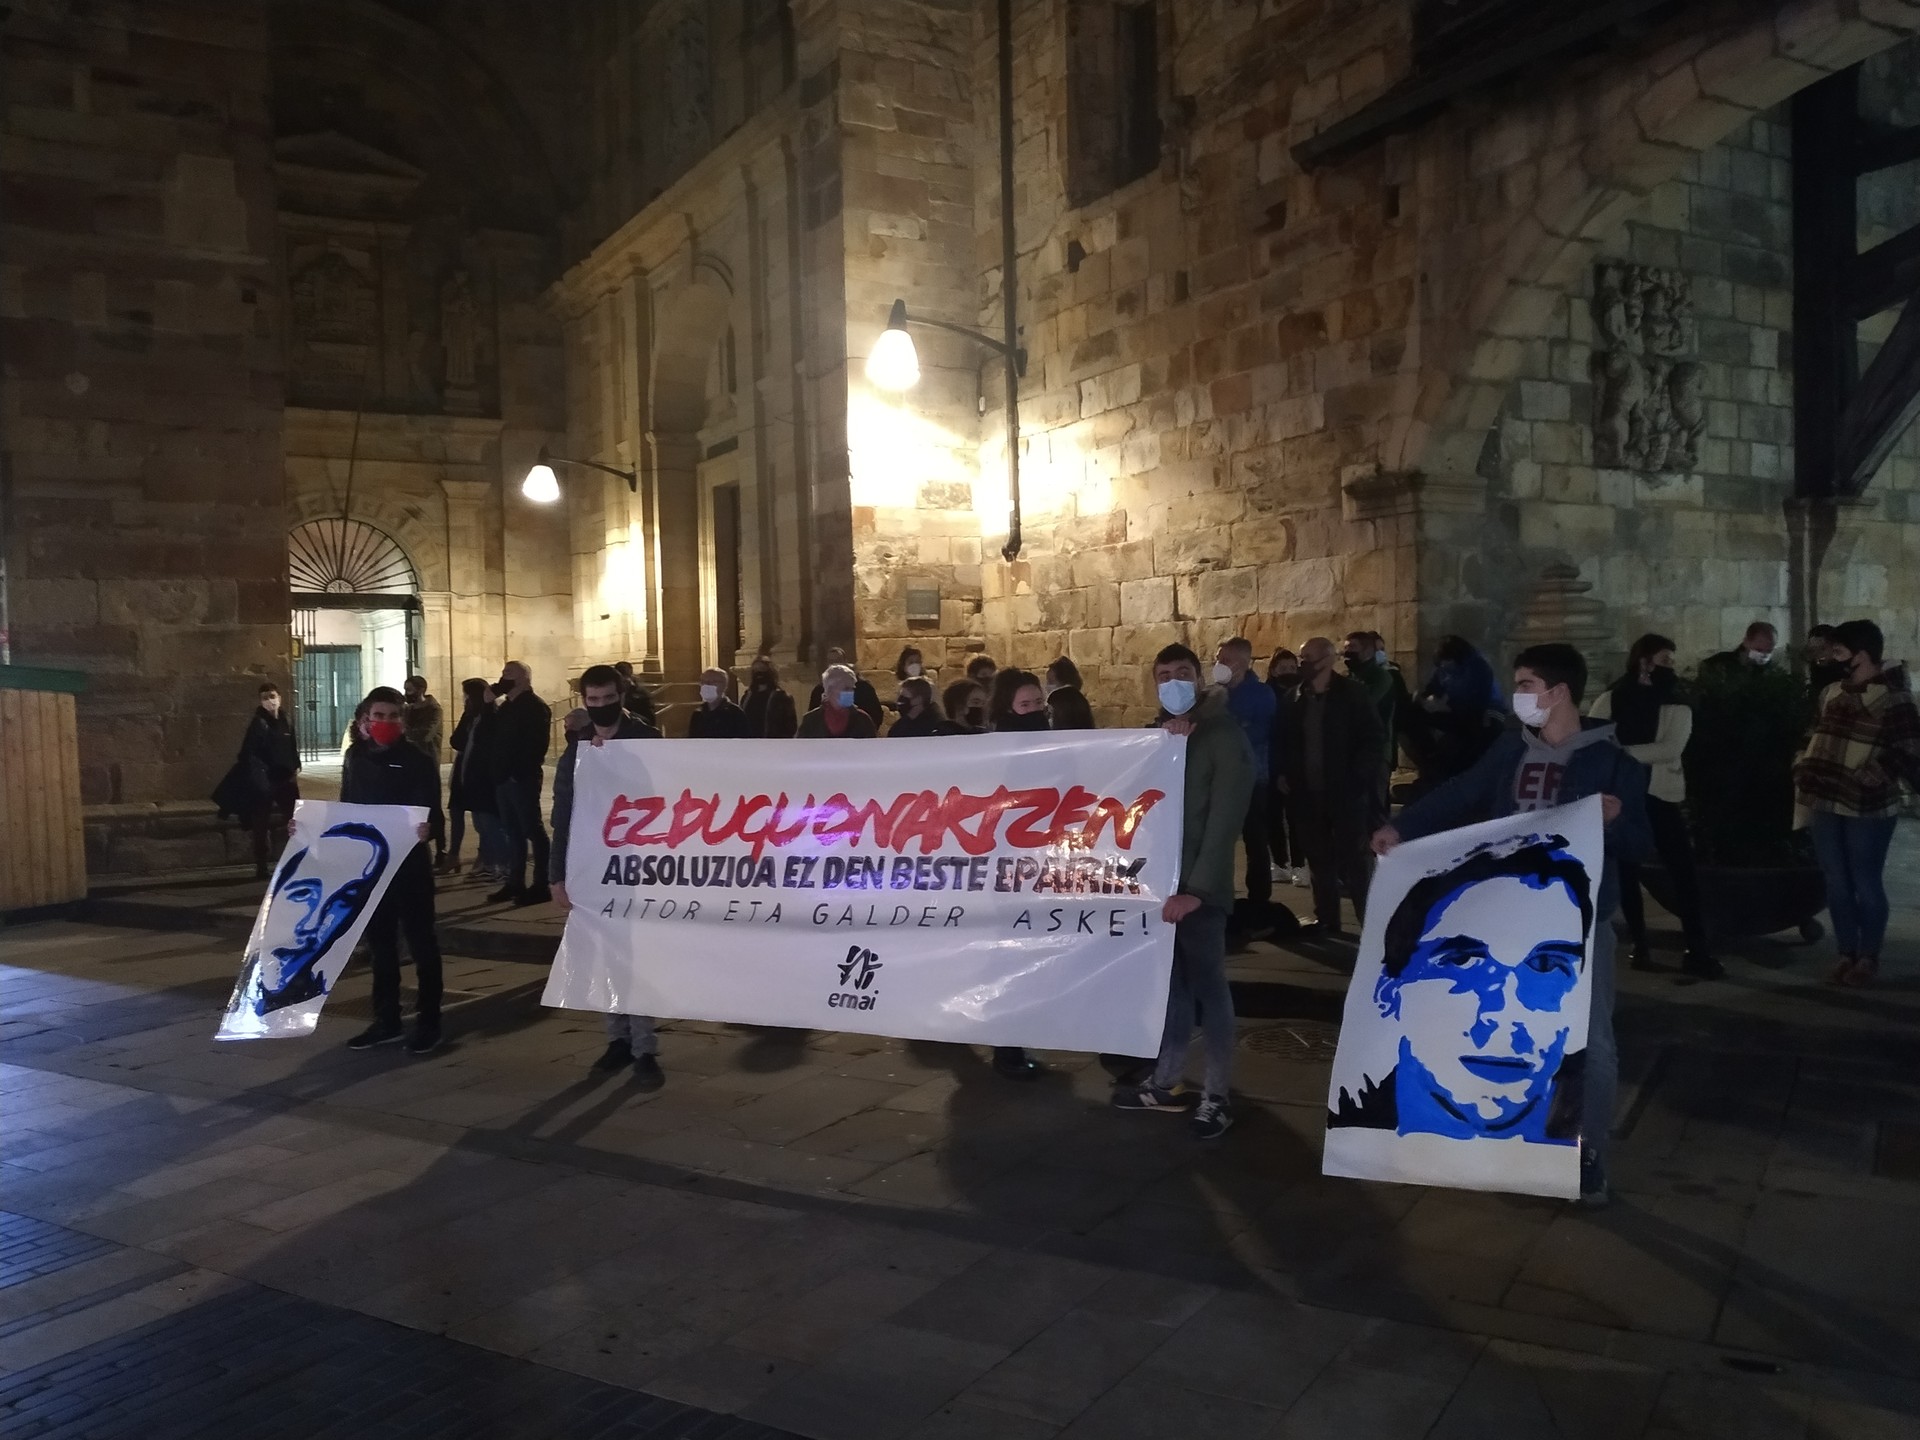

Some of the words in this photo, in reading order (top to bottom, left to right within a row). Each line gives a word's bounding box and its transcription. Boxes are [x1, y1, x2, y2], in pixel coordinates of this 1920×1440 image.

[601, 854, 776, 888] ABSOLUZIOA
[782, 856, 817, 888] EZ
[822, 856, 885, 890] DEN
[888, 855, 989, 891] BESTE
[601, 898, 702, 920] AITOR
[724, 900, 782, 923] ETA
[812, 903, 964, 928] GALDER
[1013, 908, 1149, 937] ASKE!
